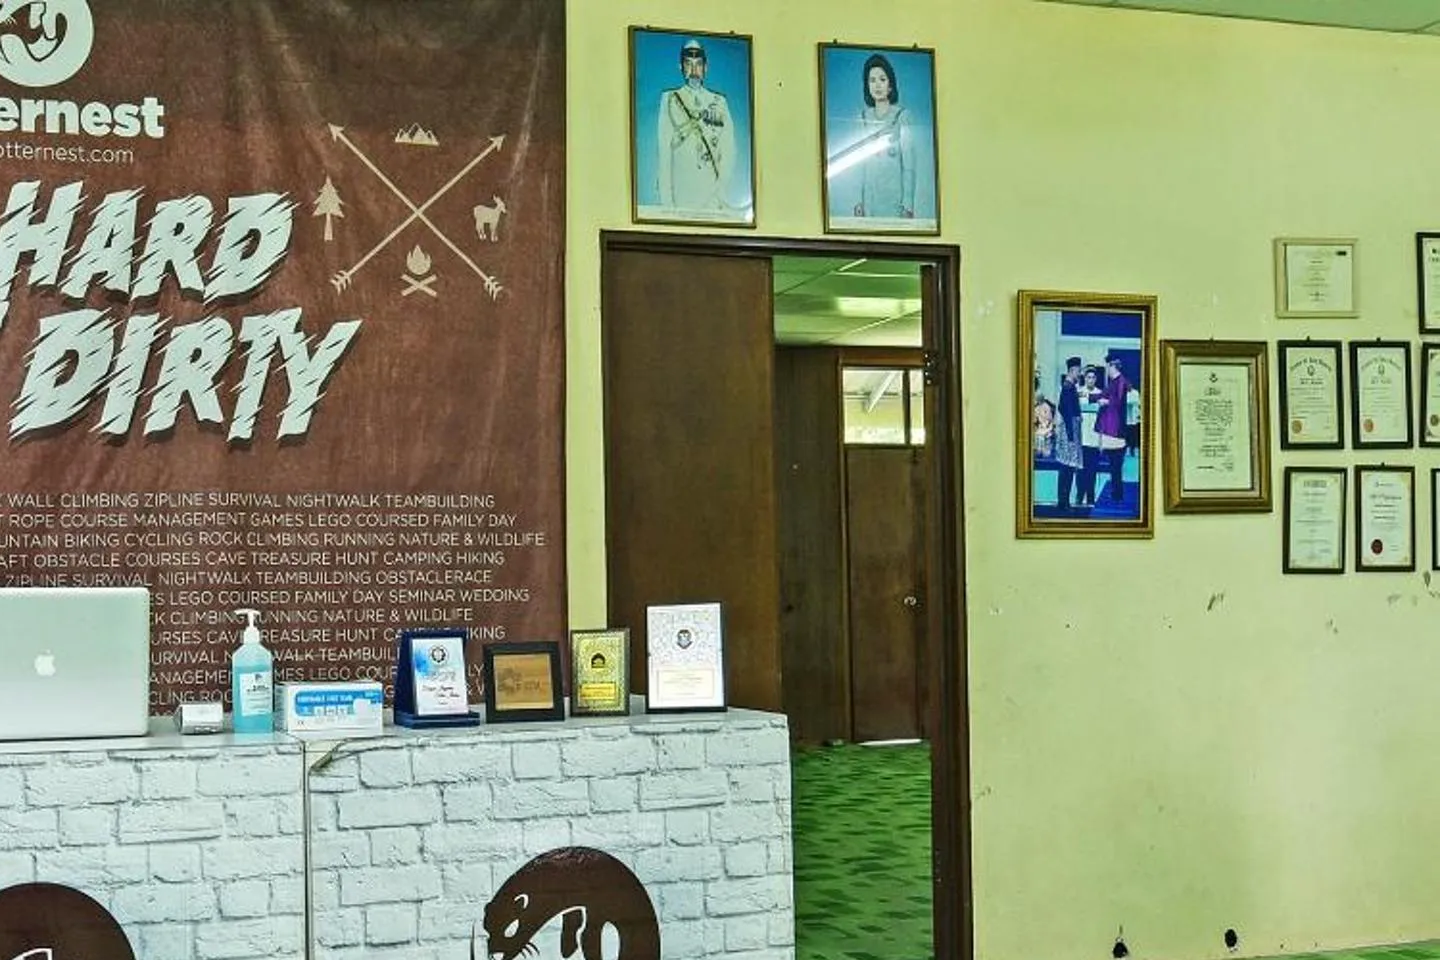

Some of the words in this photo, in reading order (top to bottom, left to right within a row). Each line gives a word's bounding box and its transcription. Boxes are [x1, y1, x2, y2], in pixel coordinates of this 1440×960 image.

[9, 306, 362, 445] DIRTY
[7, 493, 54, 508] WALL
[60, 493, 138, 508] CLIMBING
[143, 493, 203, 507] ZIPLINE
[208, 493, 281, 508] SURVIVAL
[286, 493, 380, 508] NIGHTWALK
[385, 494, 495, 509] TEAMBUILDING
[9, 514, 54, 528] ROPE
[59, 513, 127, 528] COURSE
[133, 512, 246, 527] MANAGEMENT
[250, 512, 303, 527] GAMES
[308, 512, 350, 527] LEGO
[356, 513, 429, 527] COURSED
[433, 513, 483, 527] FAMILY
[488, 513, 516, 527] DAY
[64, 533, 119, 548] BIKING
[123, 533, 193, 548] CYCLING
[198, 533, 242, 547] ROCK
[246, 533, 319, 547] CLIMBING
[323, 533, 394, 547] RUNNING
[398, 533, 458, 547] NATURE
[463, 533, 472, 547] &
[477, 533, 544, 547] WILDLIFE
[33, 553, 119, 567] OBSTACLE
[124, 552, 200, 567] COURSES
[205, 552, 246, 566] CAVE
[250, 552, 330, 566] TREASURE
[335, 552, 378, 566] HUNT
[383, 552, 452, 566] CAMPING
[456, 552, 505, 566] HIKING
[158, 571, 252, 586] NIGHTWALK
[255, 570, 371, 585] TEAMBUILDING
[376, 570, 492, 584] OBSTACLERACE
[169, 590, 212, 605] LEGO
[218, 589, 290, 604] COURSED
[294, 589, 346, 604] FAMILY
[353, 589, 384, 603] DAY
[388, 589, 455, 603] SEMINAR
[322, 608, 383, 623] NATURE
[389, 608, 399, 622] &
[404, 608, 472, 622] WILDLIFE
[335, 627, 378, 641] HUNT
[149, 647, 223, 662] URVIVAL
[308, 666, 350, 681] LEGO
